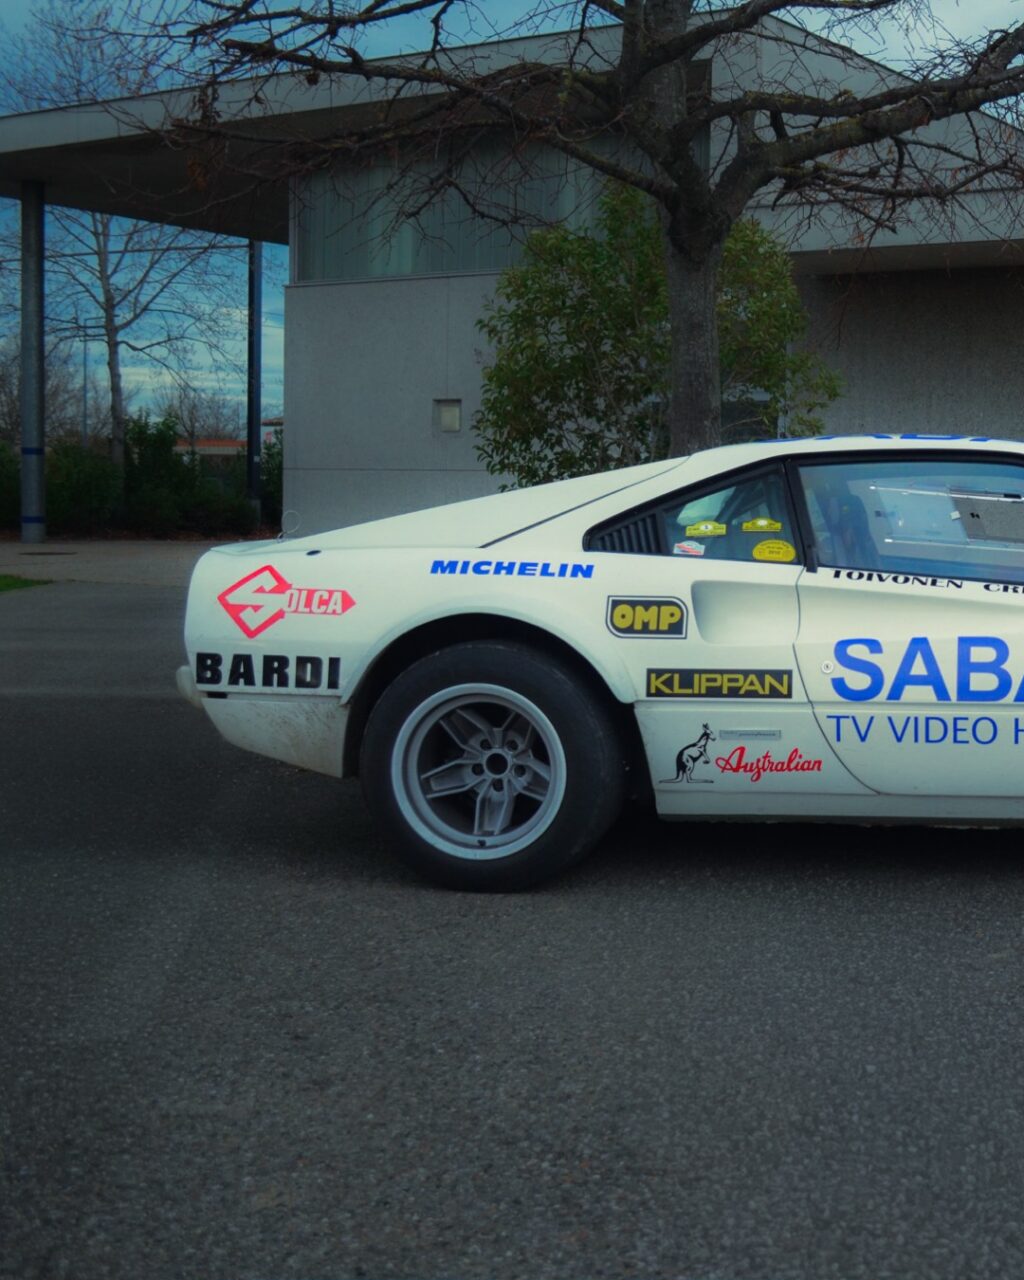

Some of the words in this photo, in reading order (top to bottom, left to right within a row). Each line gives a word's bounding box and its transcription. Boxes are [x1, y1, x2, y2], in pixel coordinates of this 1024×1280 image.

[430, 559, 595, 580] MICHELIN
[832, 569, 964, 589] TOIVONEN
[612, 603, 683, 631] OMP
[195, 651, 341, 691] BARDI
[649, 672, 791, 696] KLIPPAN
[826, 714, 876, 745] TV
[886, 715, 999, 747] VIDEO
[715, 745, 823, 783] Australian
